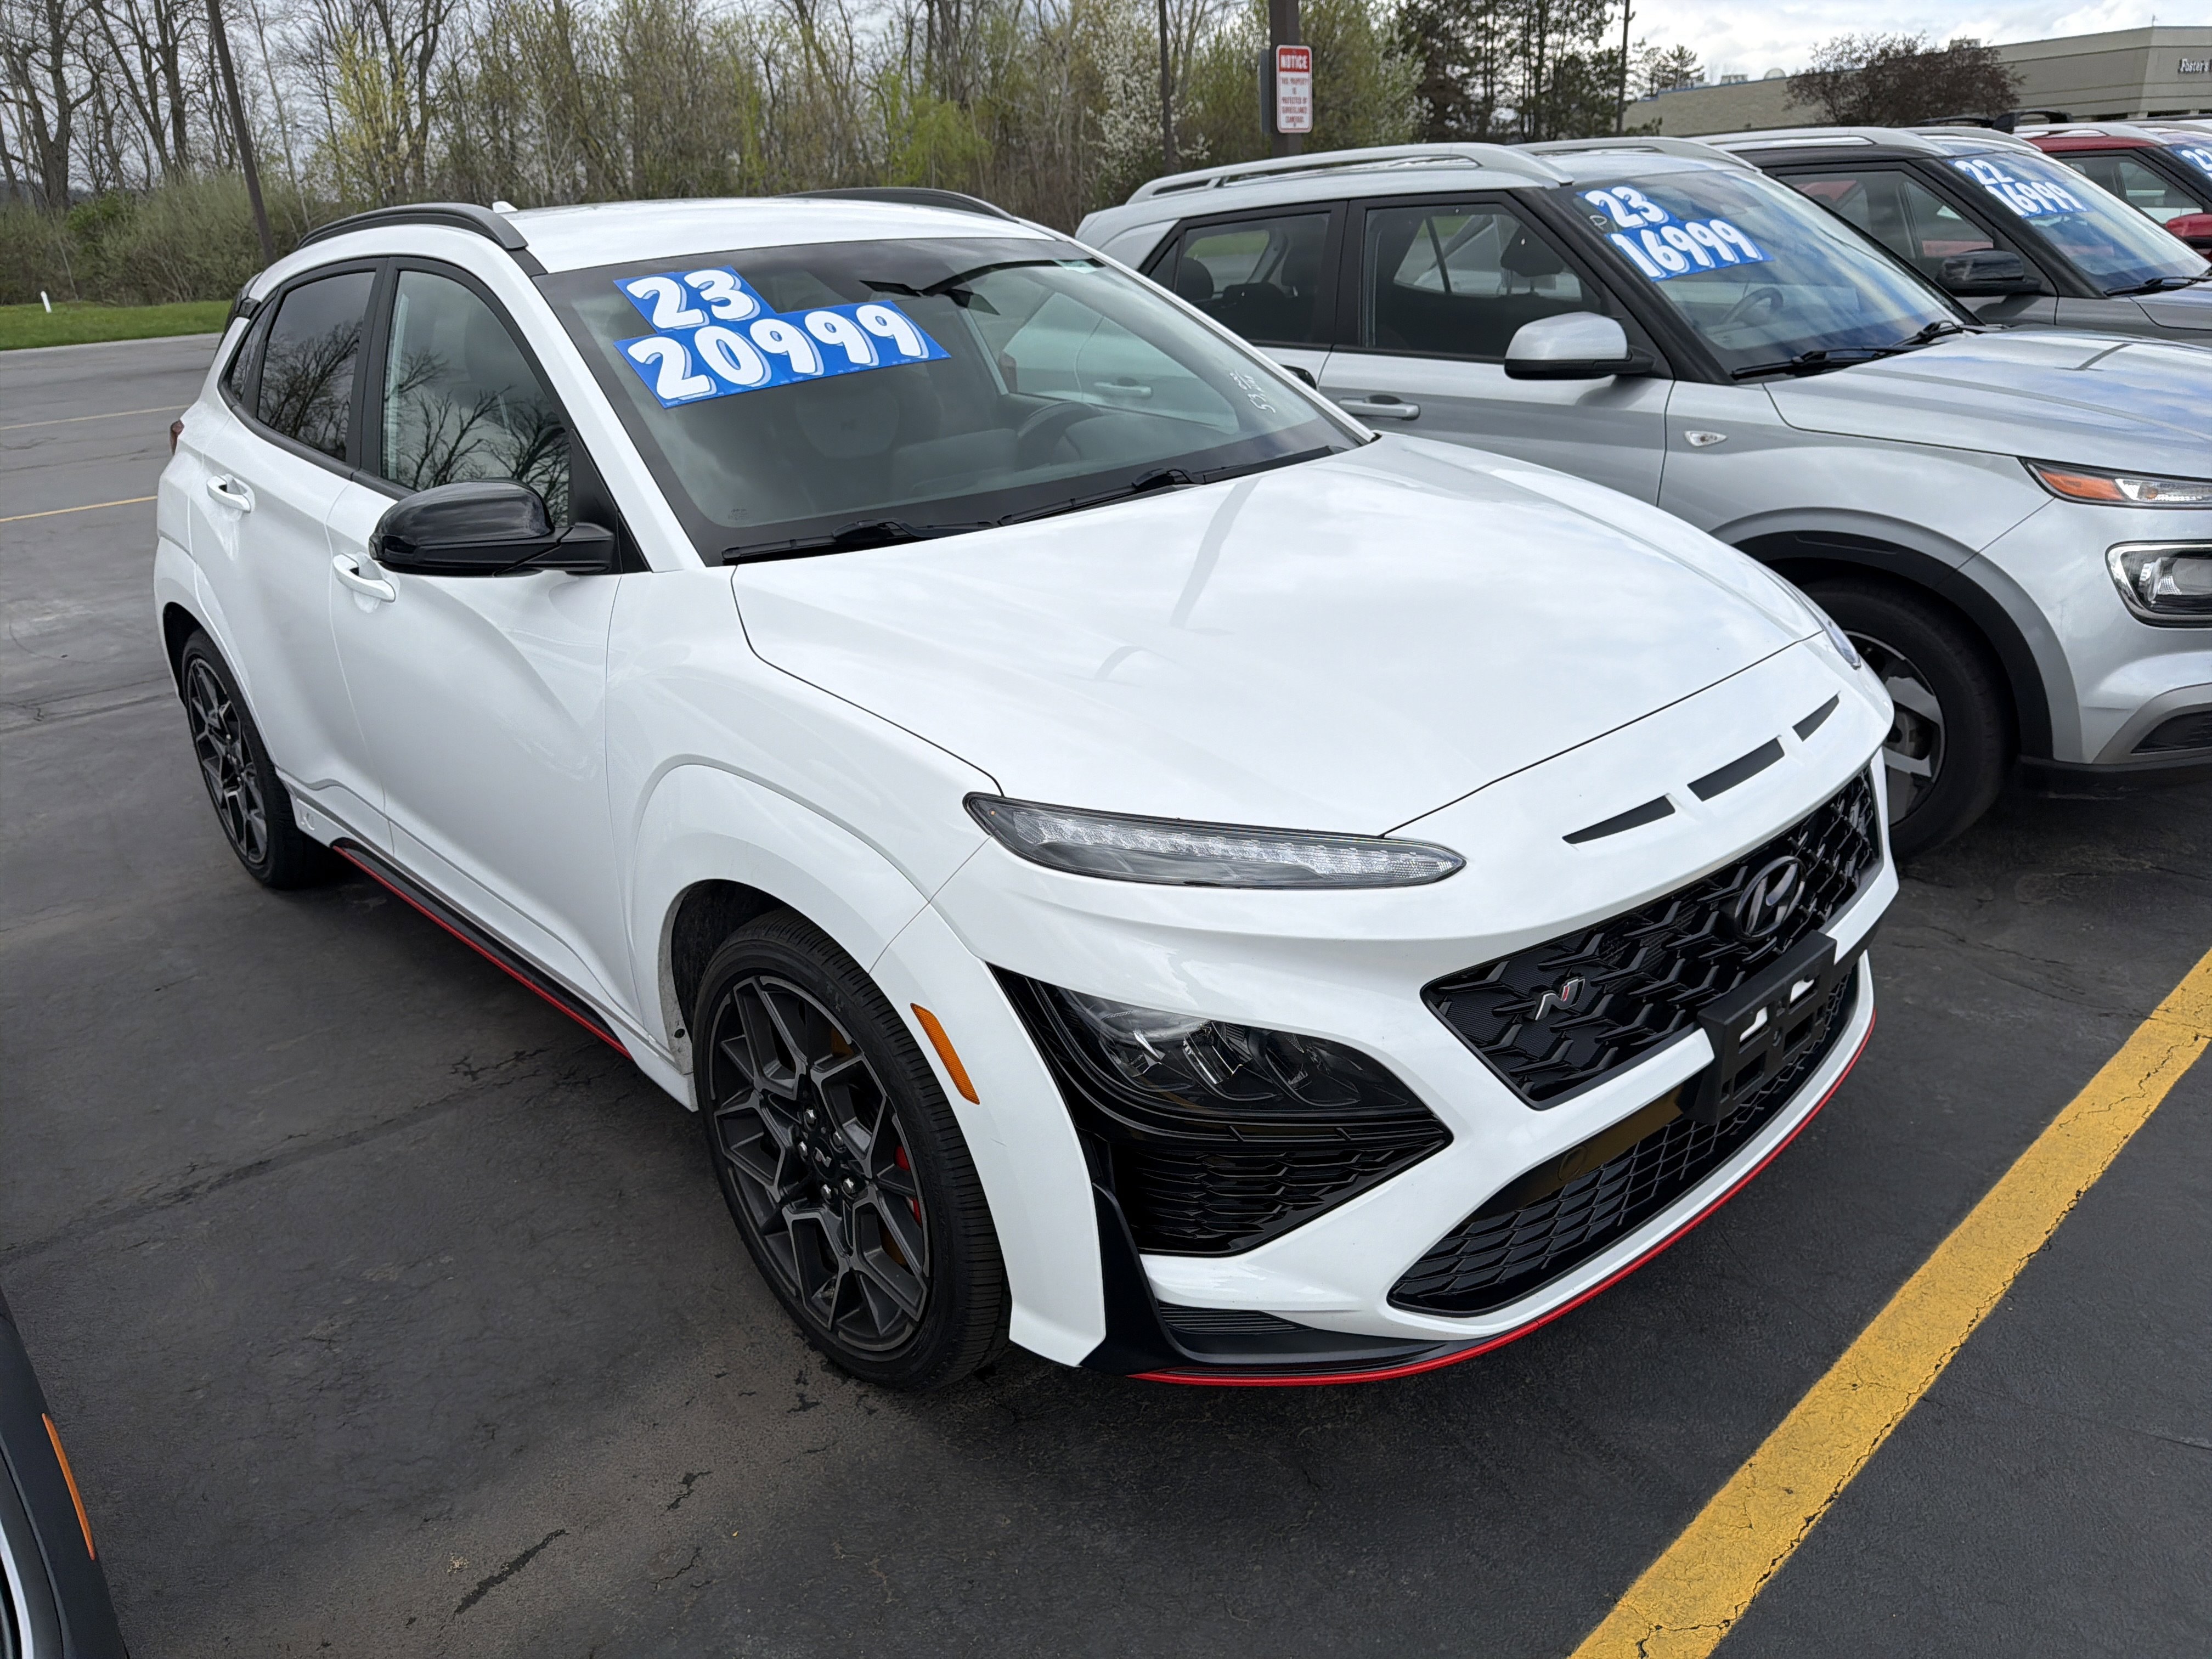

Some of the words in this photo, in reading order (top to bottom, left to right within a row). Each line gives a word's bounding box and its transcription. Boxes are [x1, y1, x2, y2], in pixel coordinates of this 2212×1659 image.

[1280, 54, 1308, 69] NOTICE
[1954, 159, 2015, 185] 22
[1584, 186, 1669, 228] 23
[1985, 182, 2087, 217] 16999
[1611, 219, 1763, 279] 16999
[627, 269, 761, 330] 23
[627, 304, 929, 400] 20999
